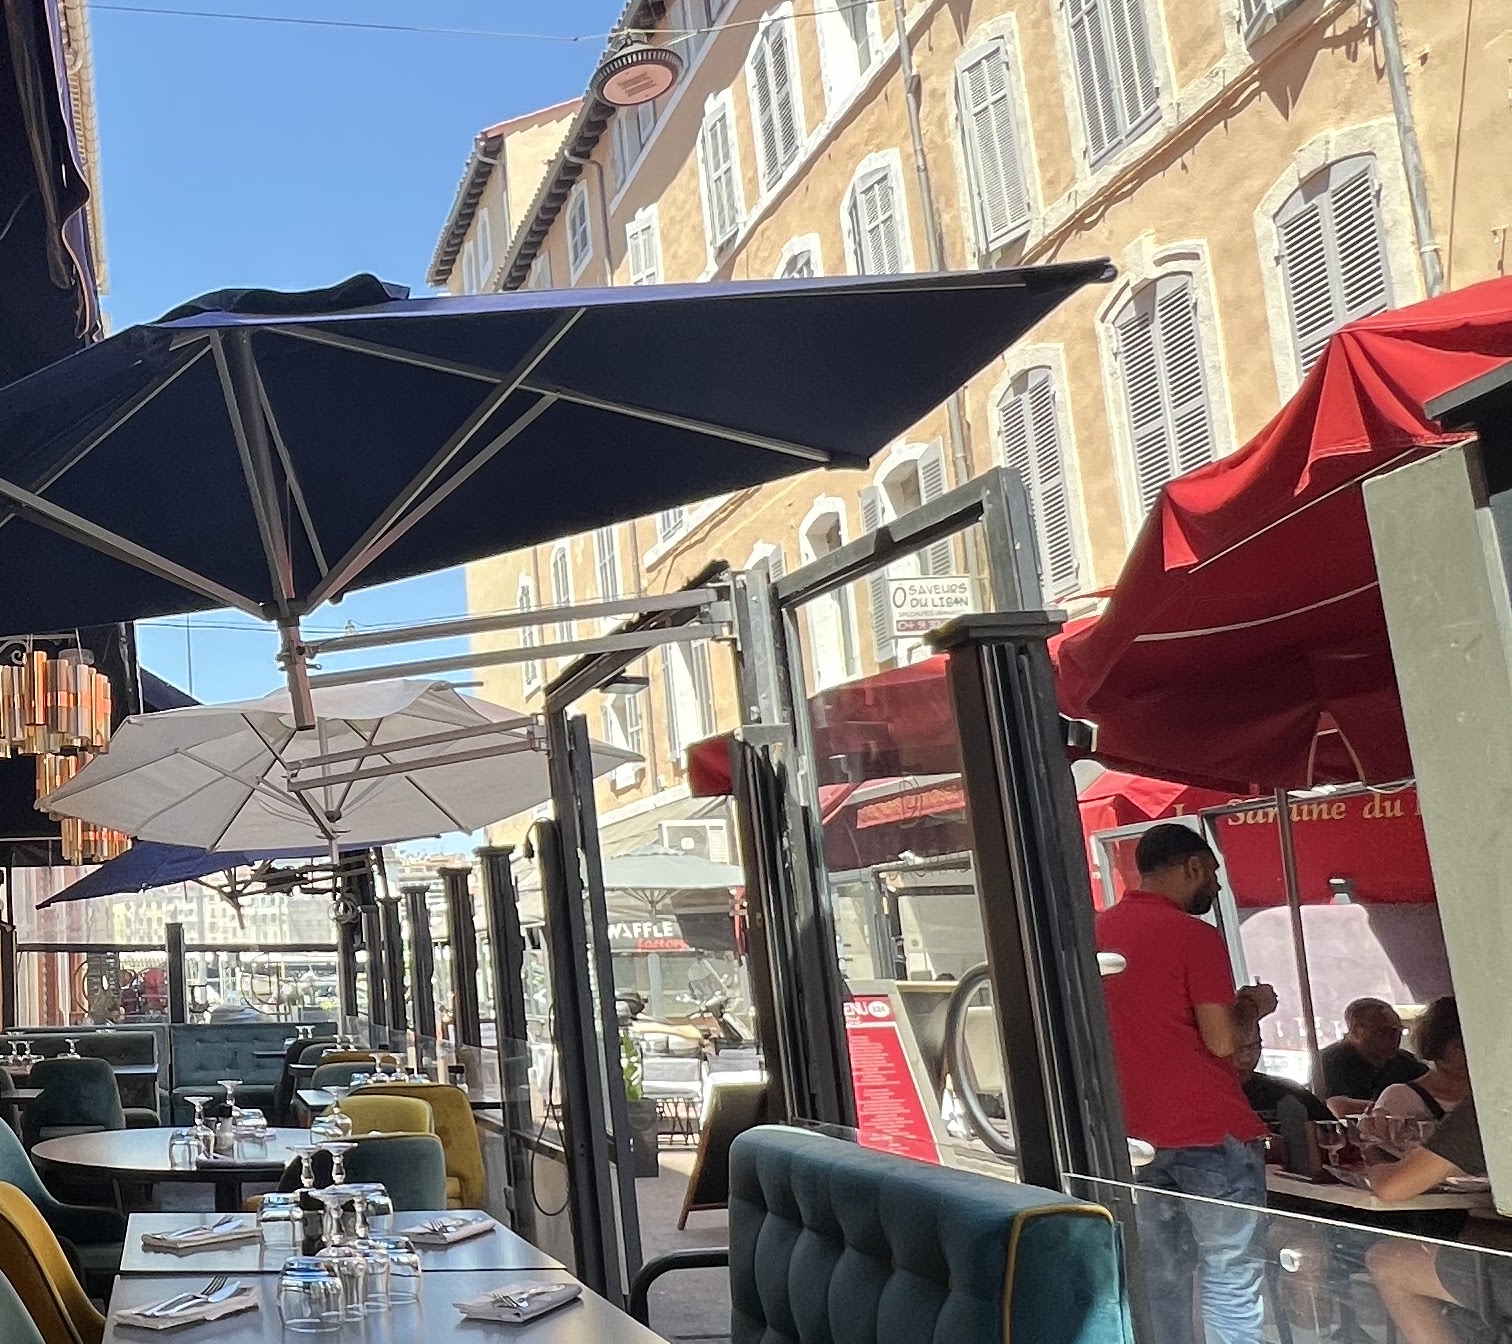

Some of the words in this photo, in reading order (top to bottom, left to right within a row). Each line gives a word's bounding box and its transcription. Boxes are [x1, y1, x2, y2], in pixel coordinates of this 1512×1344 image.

[908, 583, 967, 595] SAVEURS
[910, 598, 928, 608] DU
[1228, 798, 1346, 825] Sarine
[1363, 792, 1404, 818] du
[608, 921, 674, 939] WAFFLE
[843, 1002, 868, 1016] ENU
